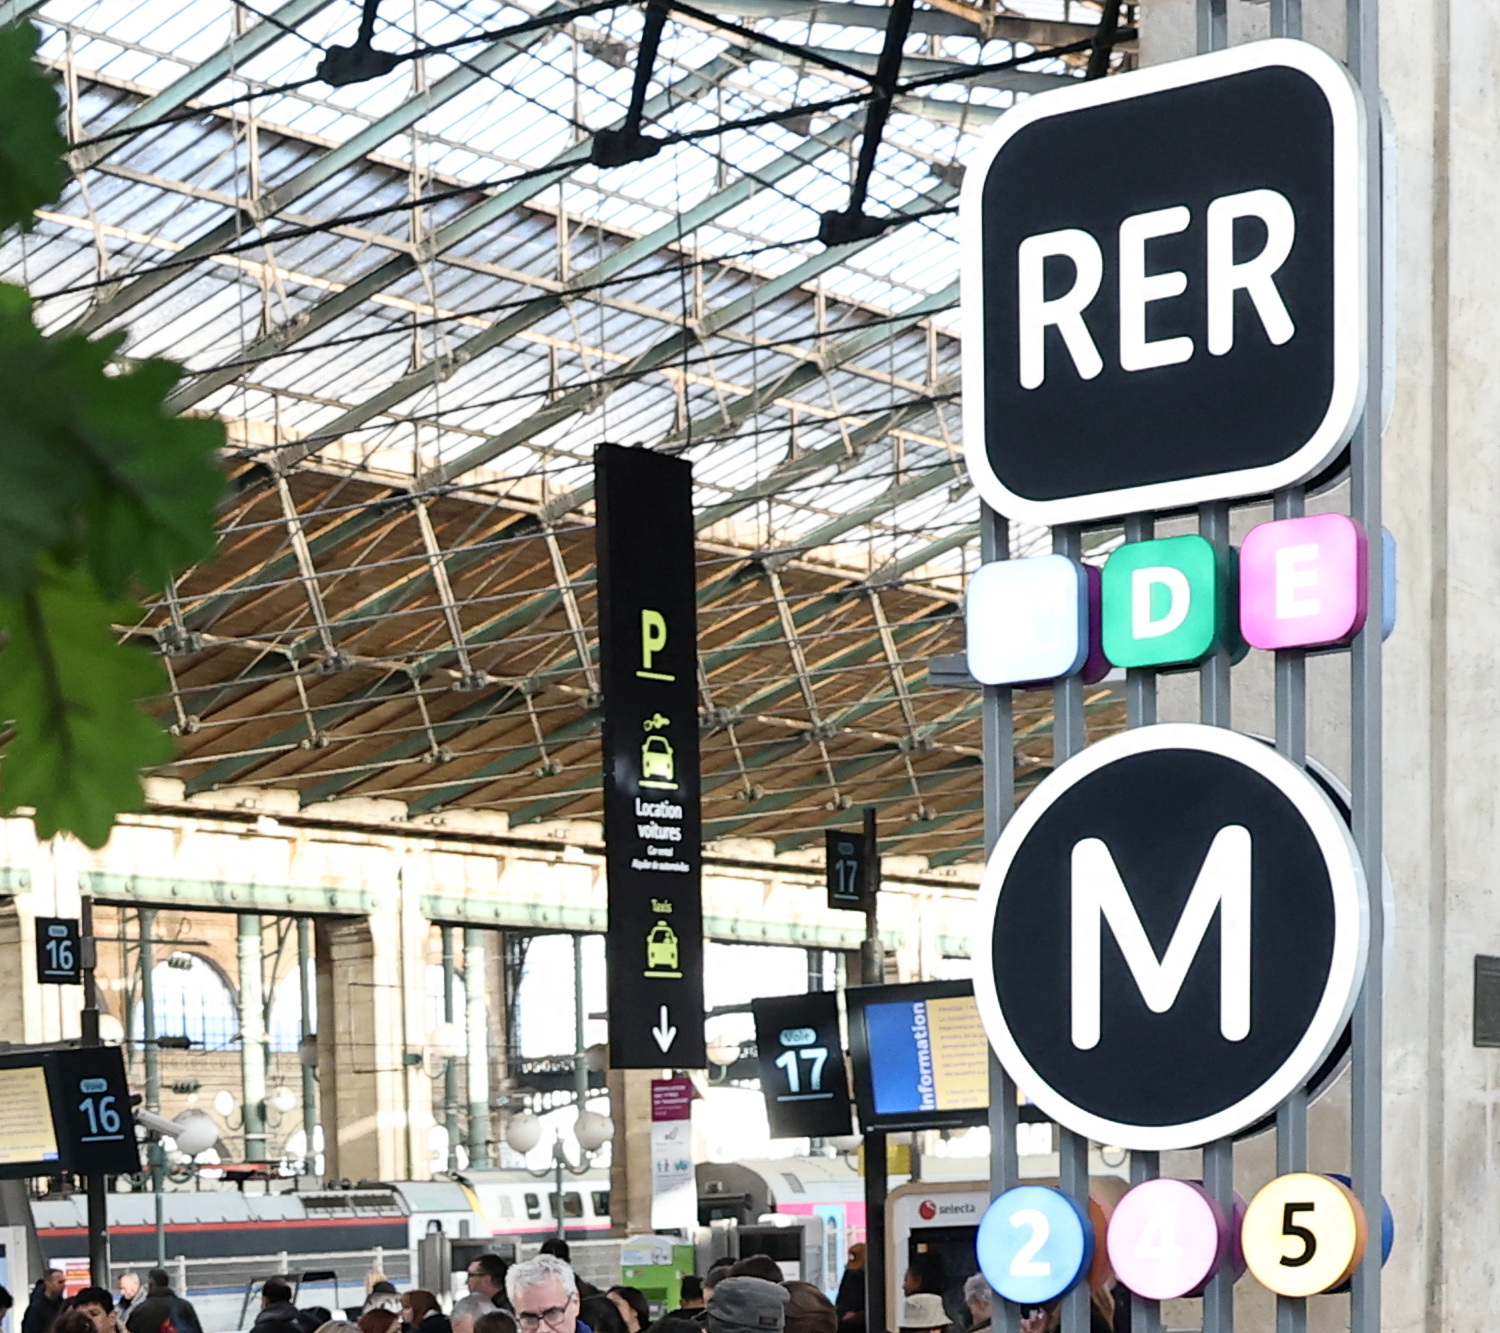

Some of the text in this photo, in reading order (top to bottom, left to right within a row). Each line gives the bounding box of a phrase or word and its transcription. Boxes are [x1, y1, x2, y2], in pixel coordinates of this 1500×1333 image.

[1018, 188, 1296, 391] RER
[1131, 565, 1191, 640] D
[1275, 543, 1321, 620] E
[640, 608, 668, 670] P
[634, 797, 683, 819] Location
[636, 820, 682, 842] voitures
[835, 859, 858, 893] 17
[45, 939, 74, 970] 16
[1070, 824, 1252, 1050] M
[774, 1047, 829, 1092] 17
[910, 1001, 937, 1112] Information
[78, 1096, 121, 1134] 16
[1008, 1208, 1052, 1277] 2
[1134, 1216, 1184, 1279] 4
[1279, 1200, 1318, 1268] 5
